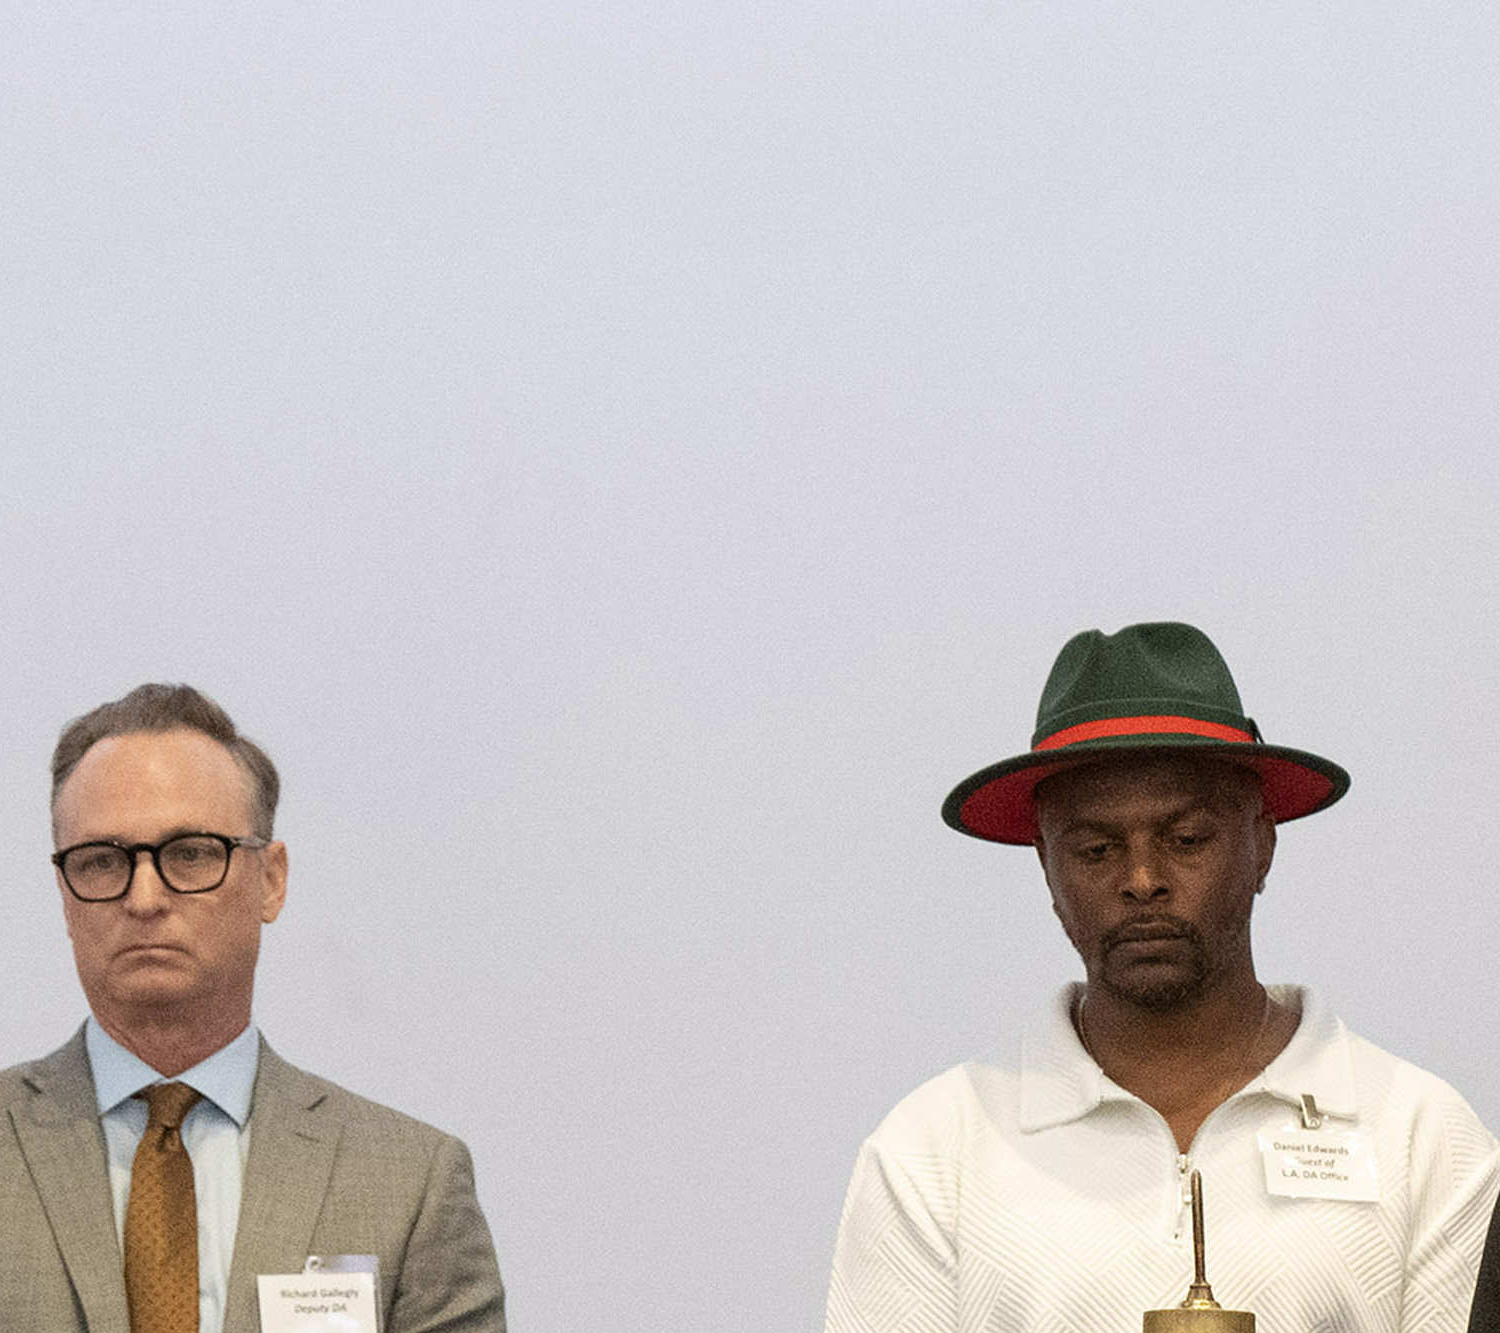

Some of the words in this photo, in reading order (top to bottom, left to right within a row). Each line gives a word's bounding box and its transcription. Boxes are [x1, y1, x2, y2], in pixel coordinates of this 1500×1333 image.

[1307, 1145, 1349, 1156] Edwards
[1324, 1159, 1336, 1168] of
[1303, 1170, 1318, 1179] DA
[294, 1303, 329, 1314] Deputy
[332, 1303, 347, 1312] DA
